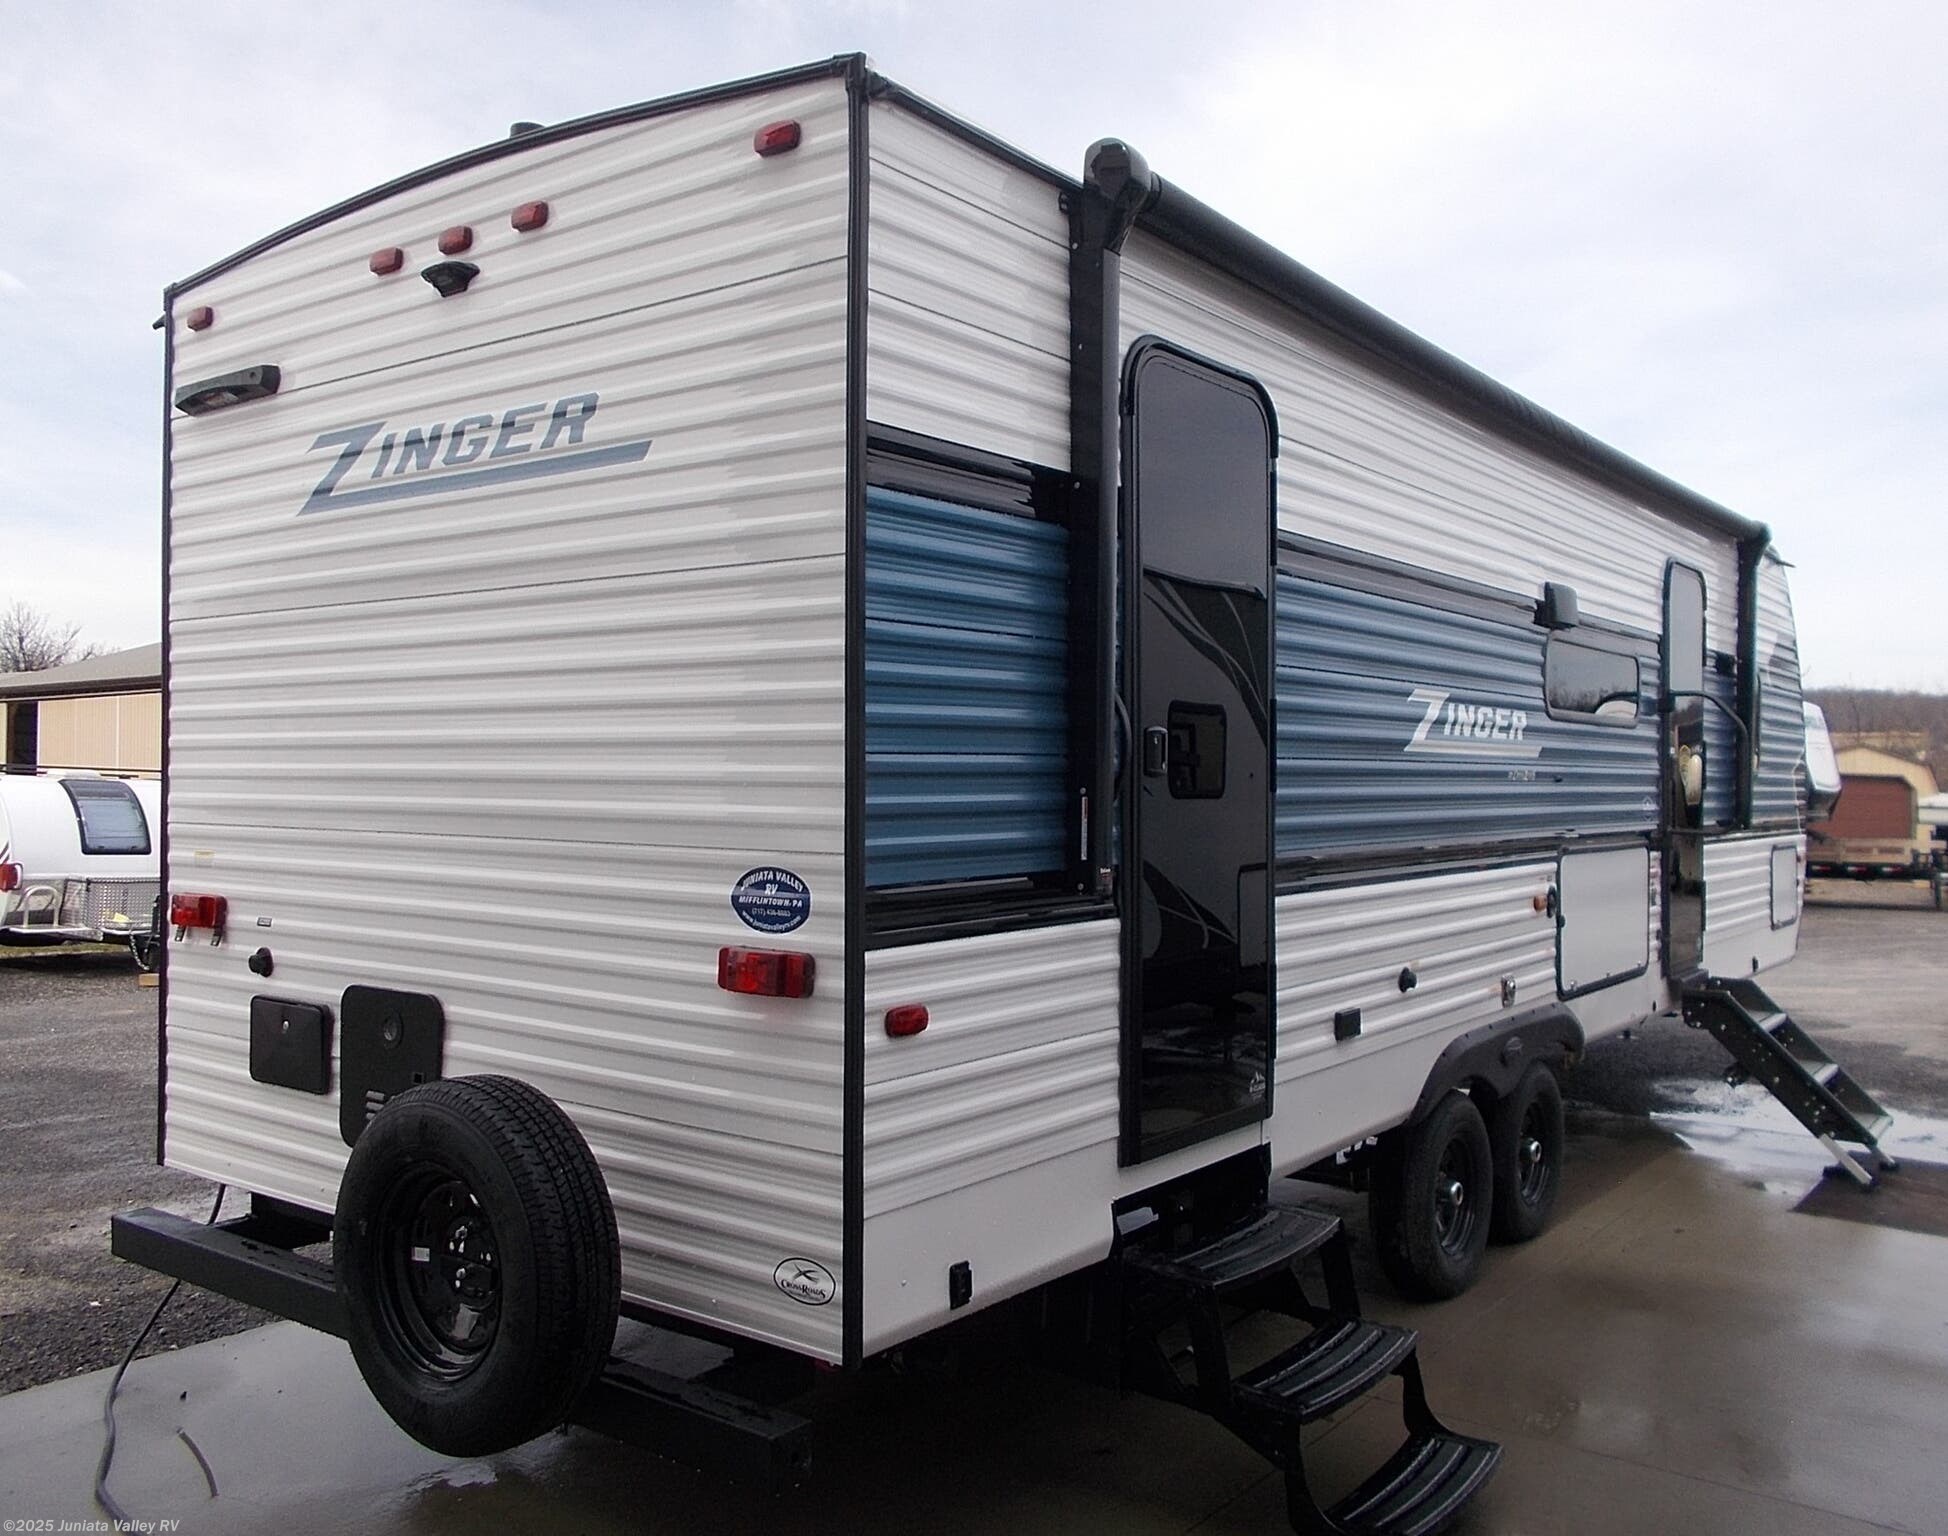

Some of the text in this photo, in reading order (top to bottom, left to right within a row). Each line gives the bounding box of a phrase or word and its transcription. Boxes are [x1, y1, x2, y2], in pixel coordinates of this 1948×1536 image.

[296, 391, 653, 516] ZINGER
[1403, 688, 1543, 758] ZINGER
[741, 871, 803, 892] JUNIATA VALLEY
[764, 883, 778, 895] RV
[792, 899, 802, 908] PA
